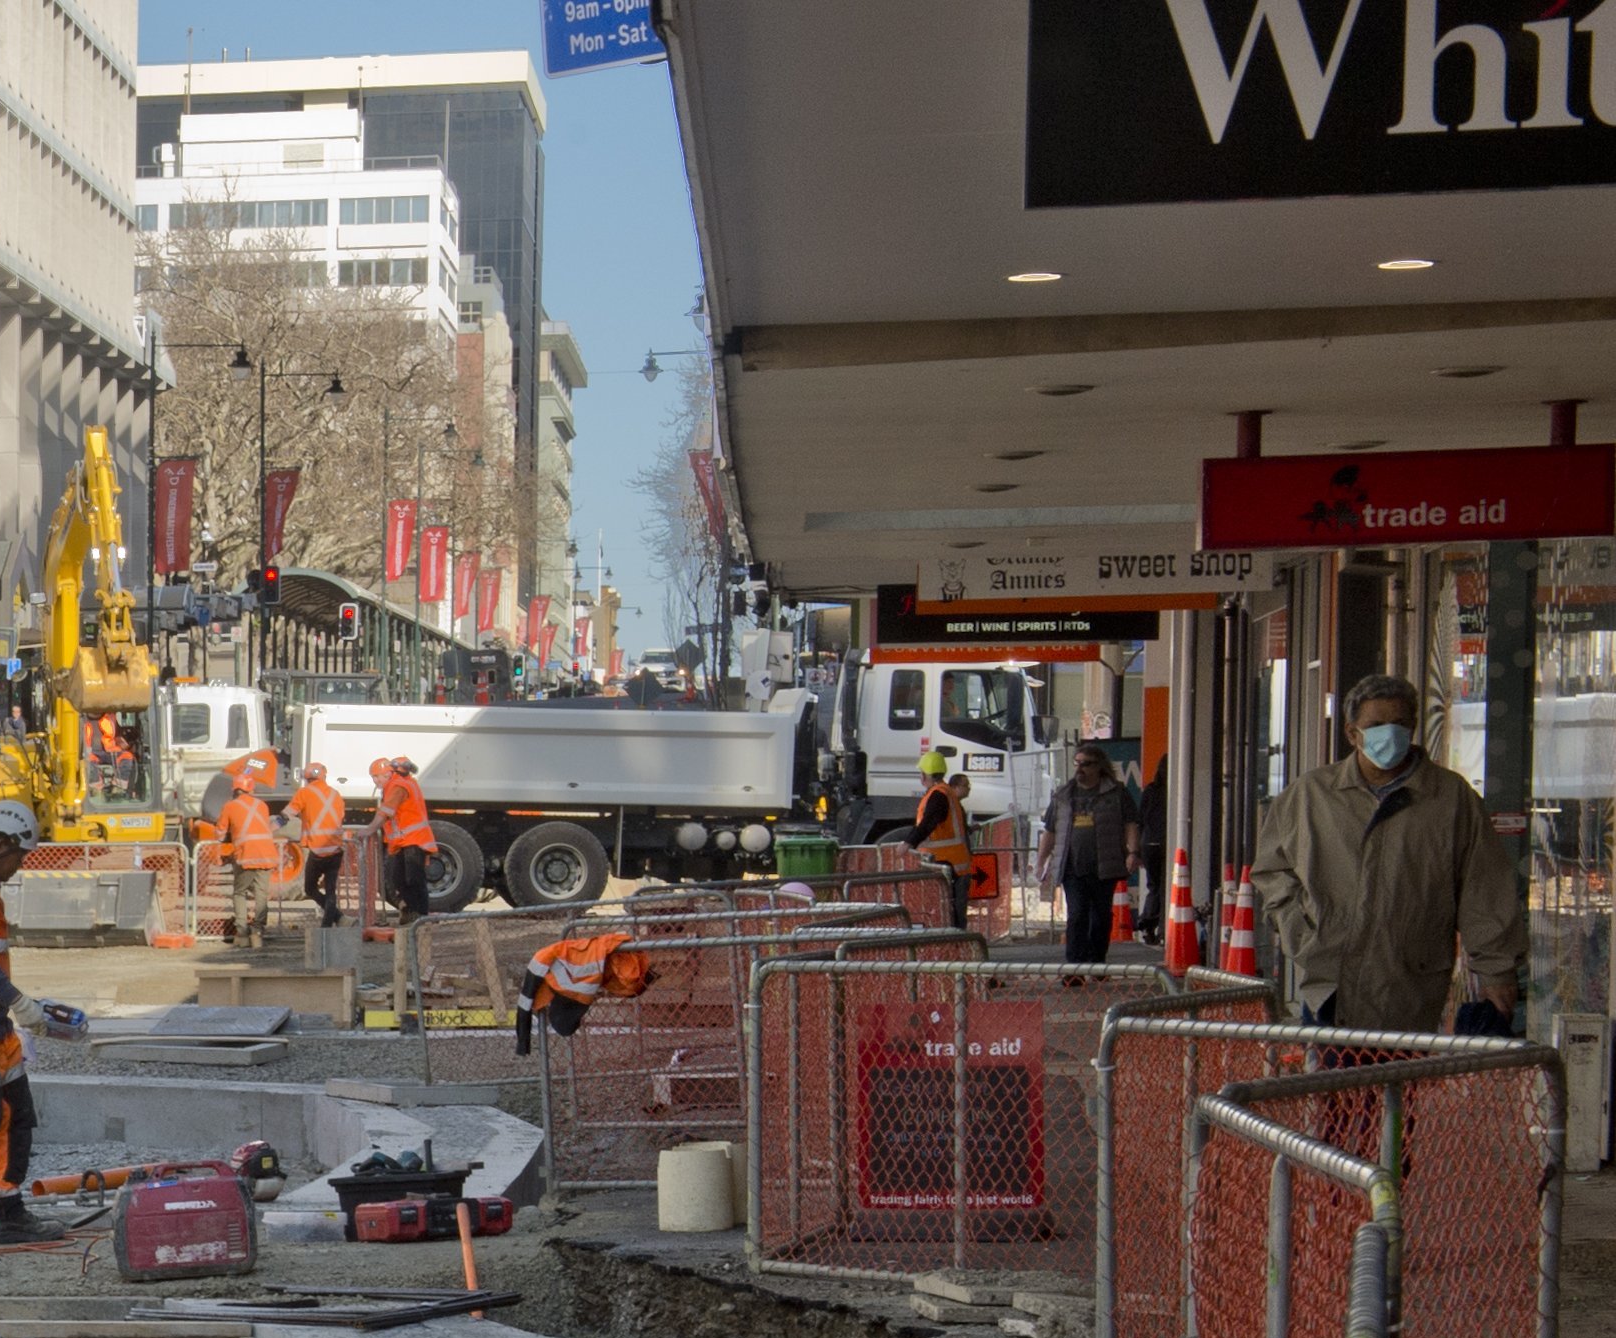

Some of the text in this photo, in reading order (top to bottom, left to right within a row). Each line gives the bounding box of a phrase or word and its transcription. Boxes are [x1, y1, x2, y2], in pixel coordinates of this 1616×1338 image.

[1362, 499, 1506, 528] trade aid
[988, 569, 1066, 591] Annies
[946, 621, 1090, 632] BEER WINE SPIRITS RTDs
[924, 1037, 1022, 1057] trae aid
